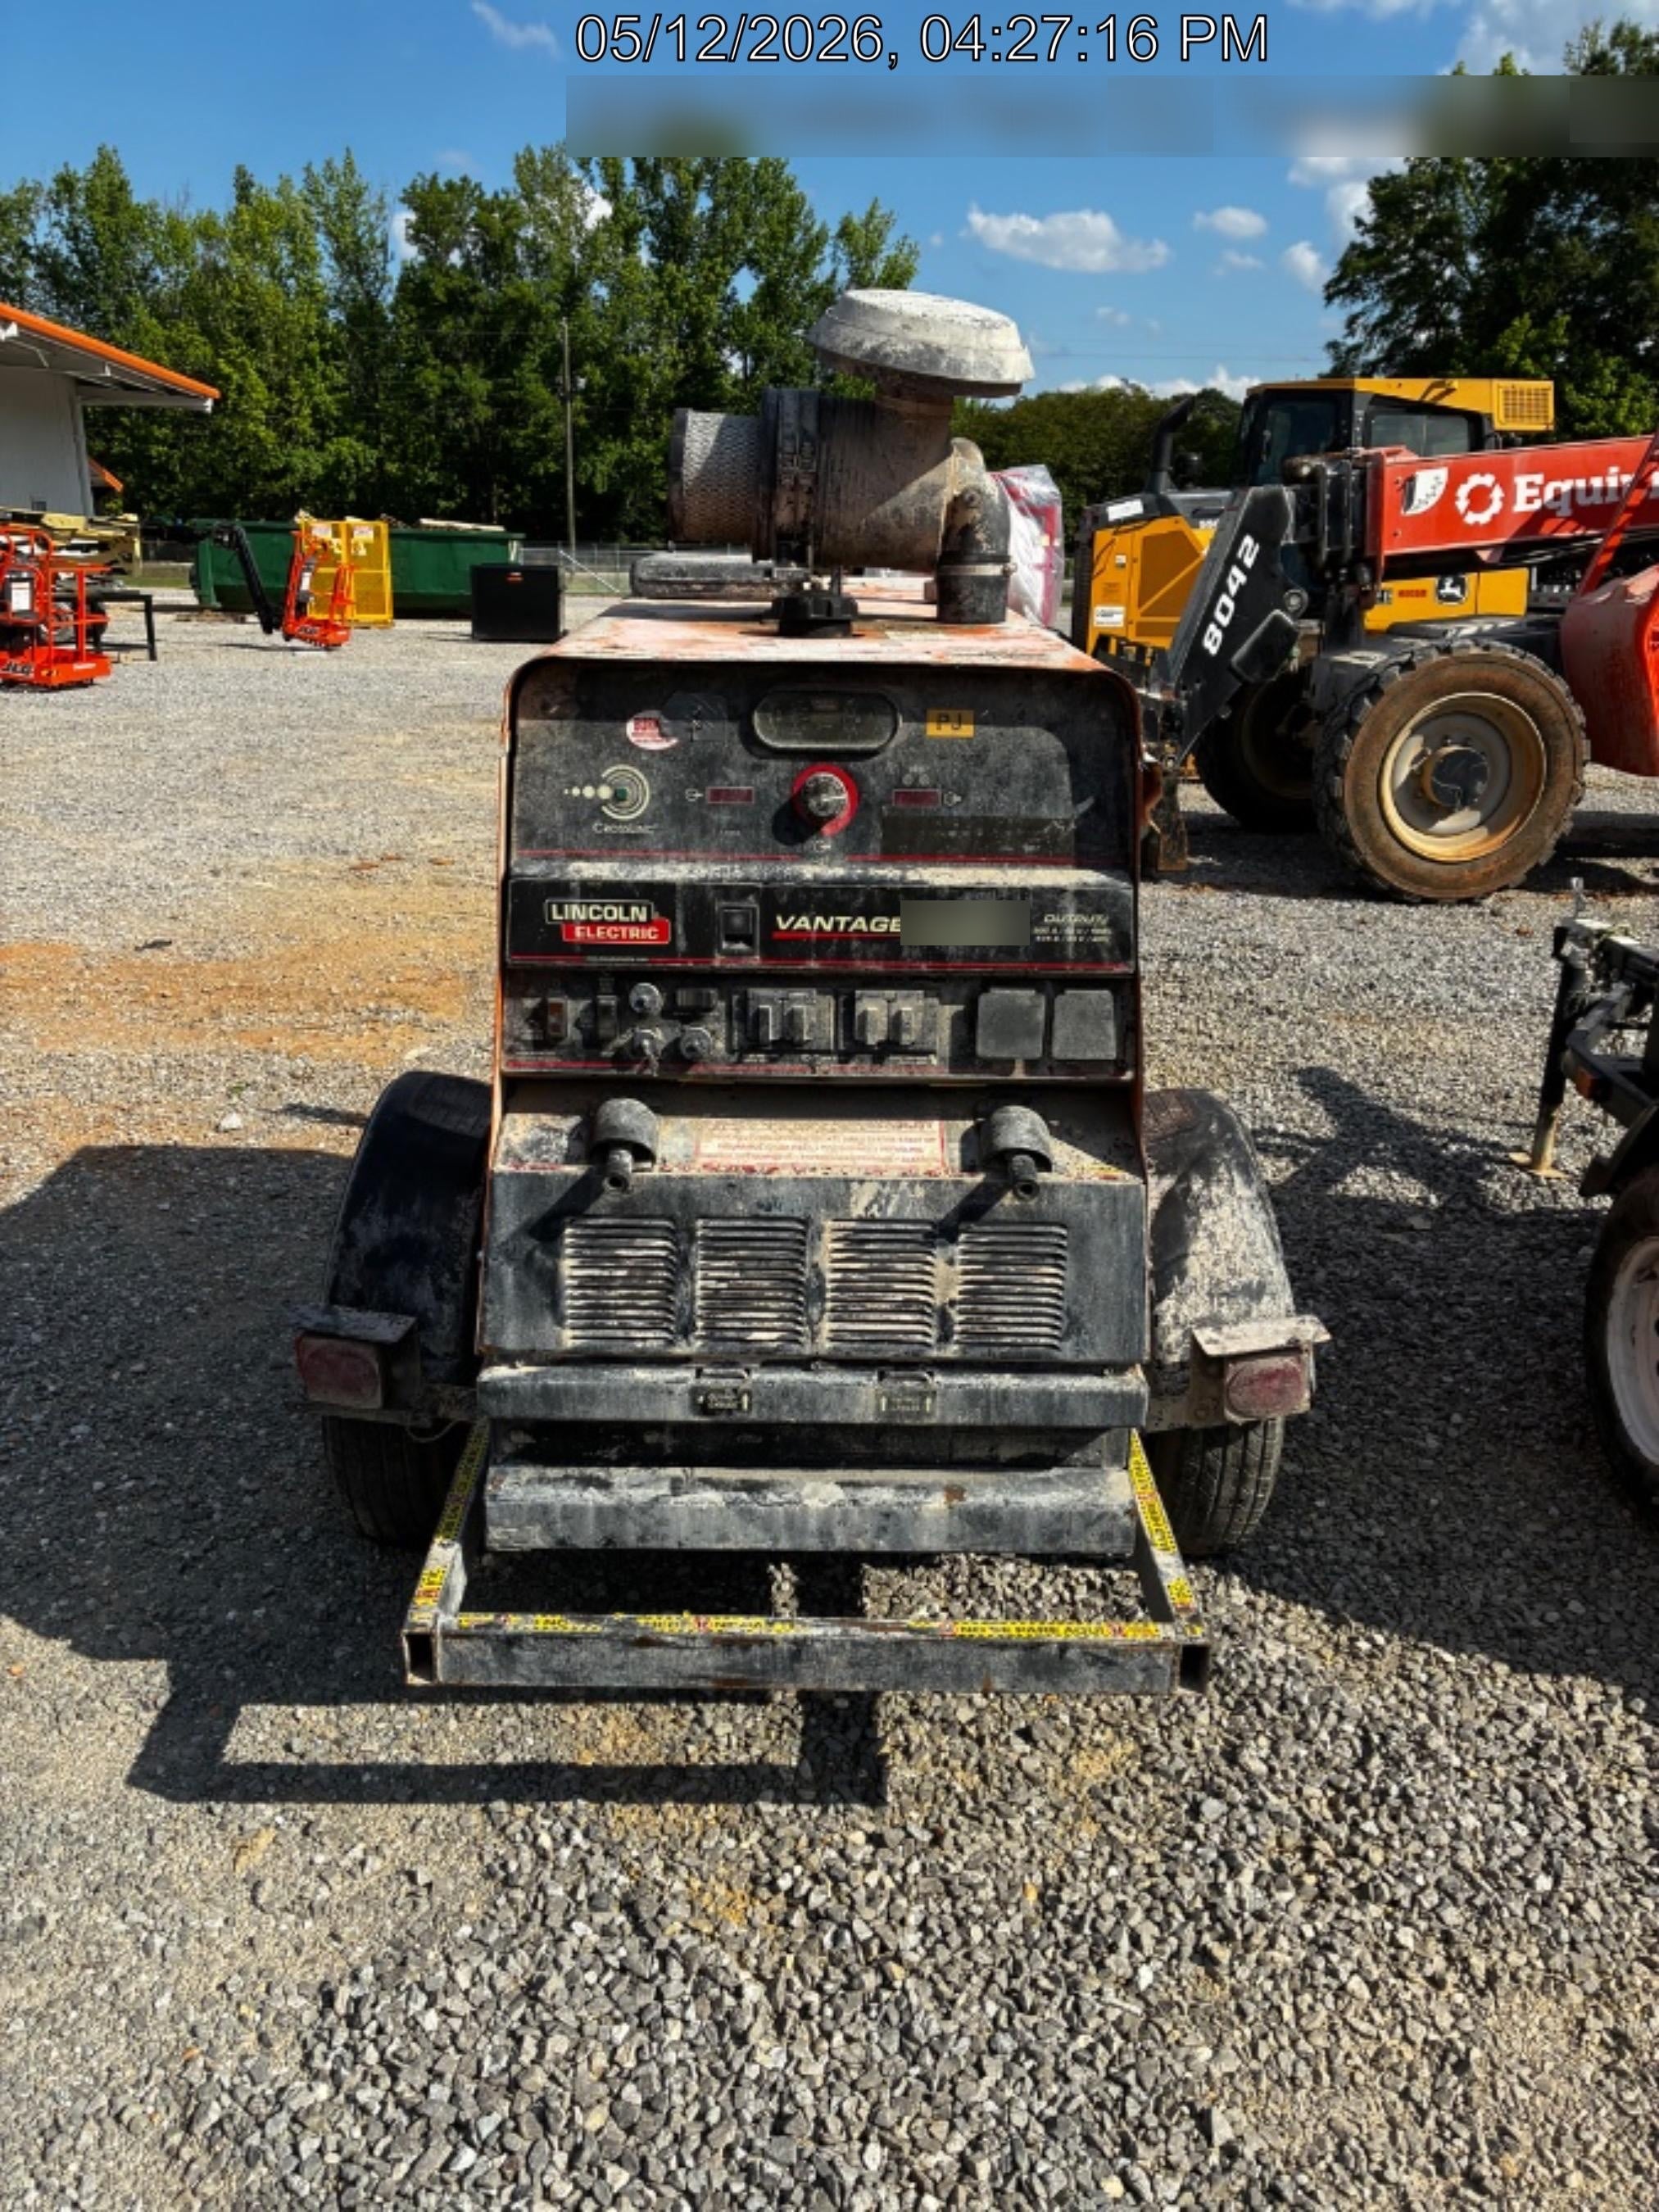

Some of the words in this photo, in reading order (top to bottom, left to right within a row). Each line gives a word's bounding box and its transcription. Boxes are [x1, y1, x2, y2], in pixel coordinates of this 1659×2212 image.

[1203, 534, 1260, 656] 8042
[936, 712, 963, 730] PJ
[551, 904, 647, 922] LINCOLN
[776, 915, 901, 932] VANTAGE
[574, 926, 660, 940] ELECTRIC
